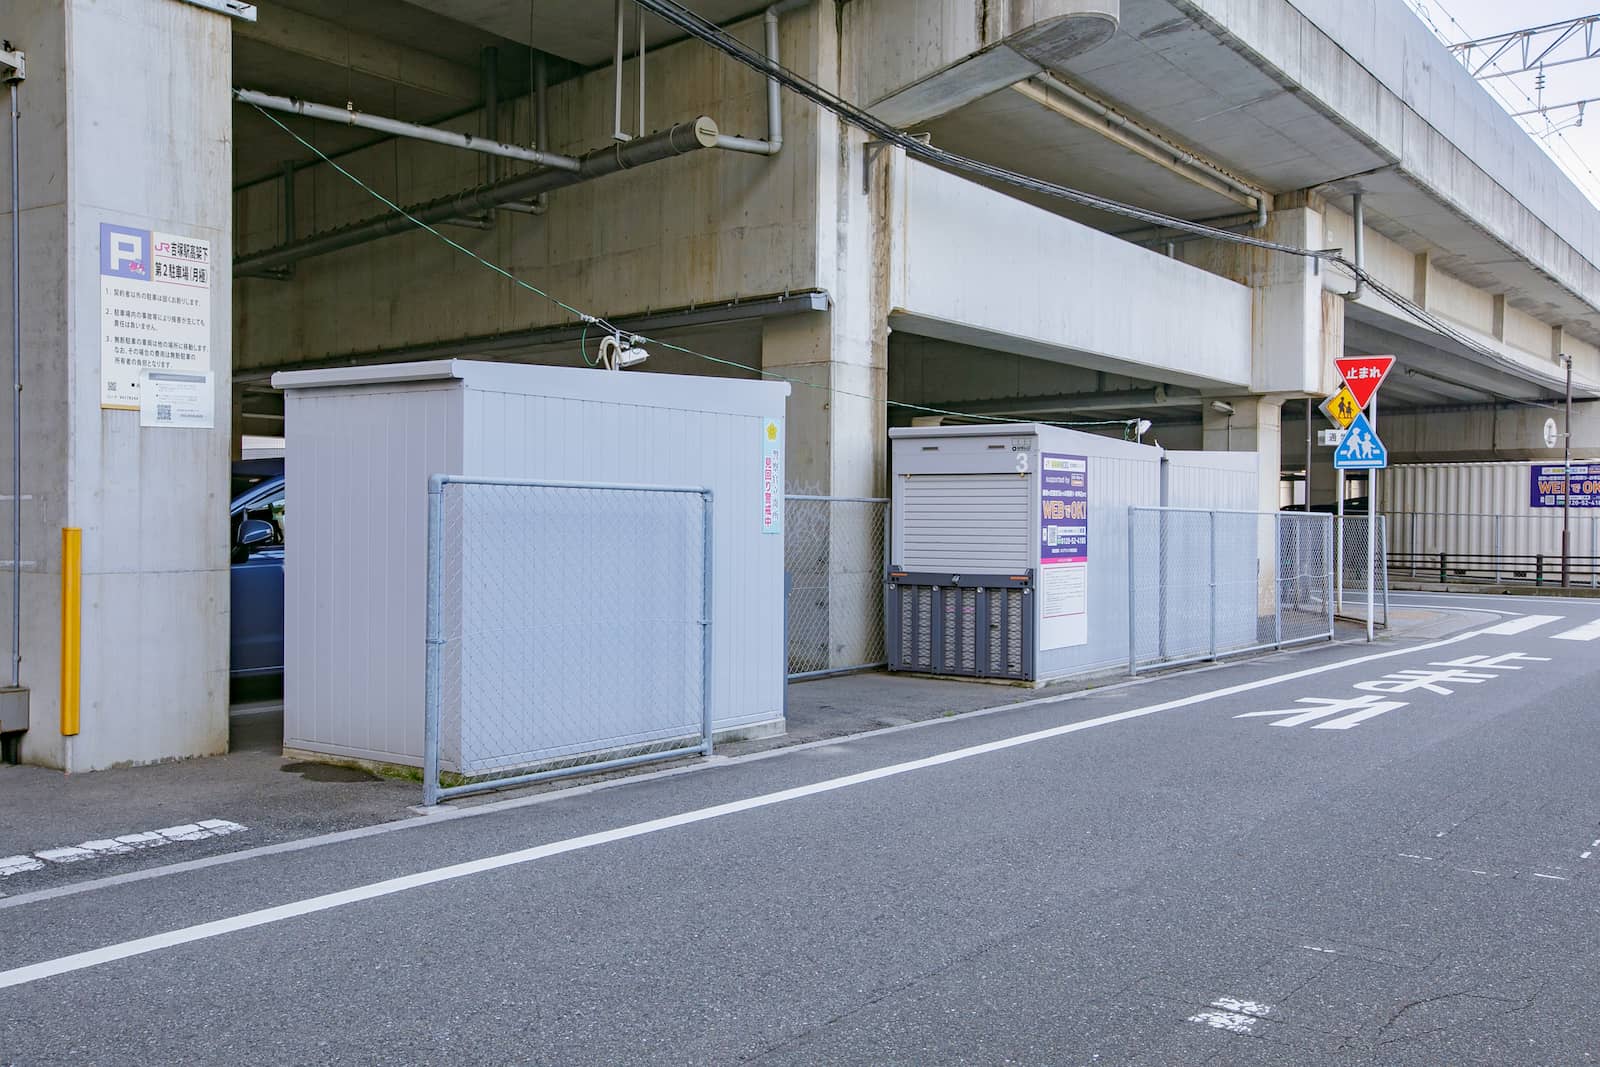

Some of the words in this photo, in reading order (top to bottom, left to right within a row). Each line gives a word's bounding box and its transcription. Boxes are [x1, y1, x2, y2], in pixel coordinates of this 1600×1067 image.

[110, 231, 142, 271] P
[1345, 366, 1382, 379] 止まれ
[1015, 453, 1029, 473] 3
